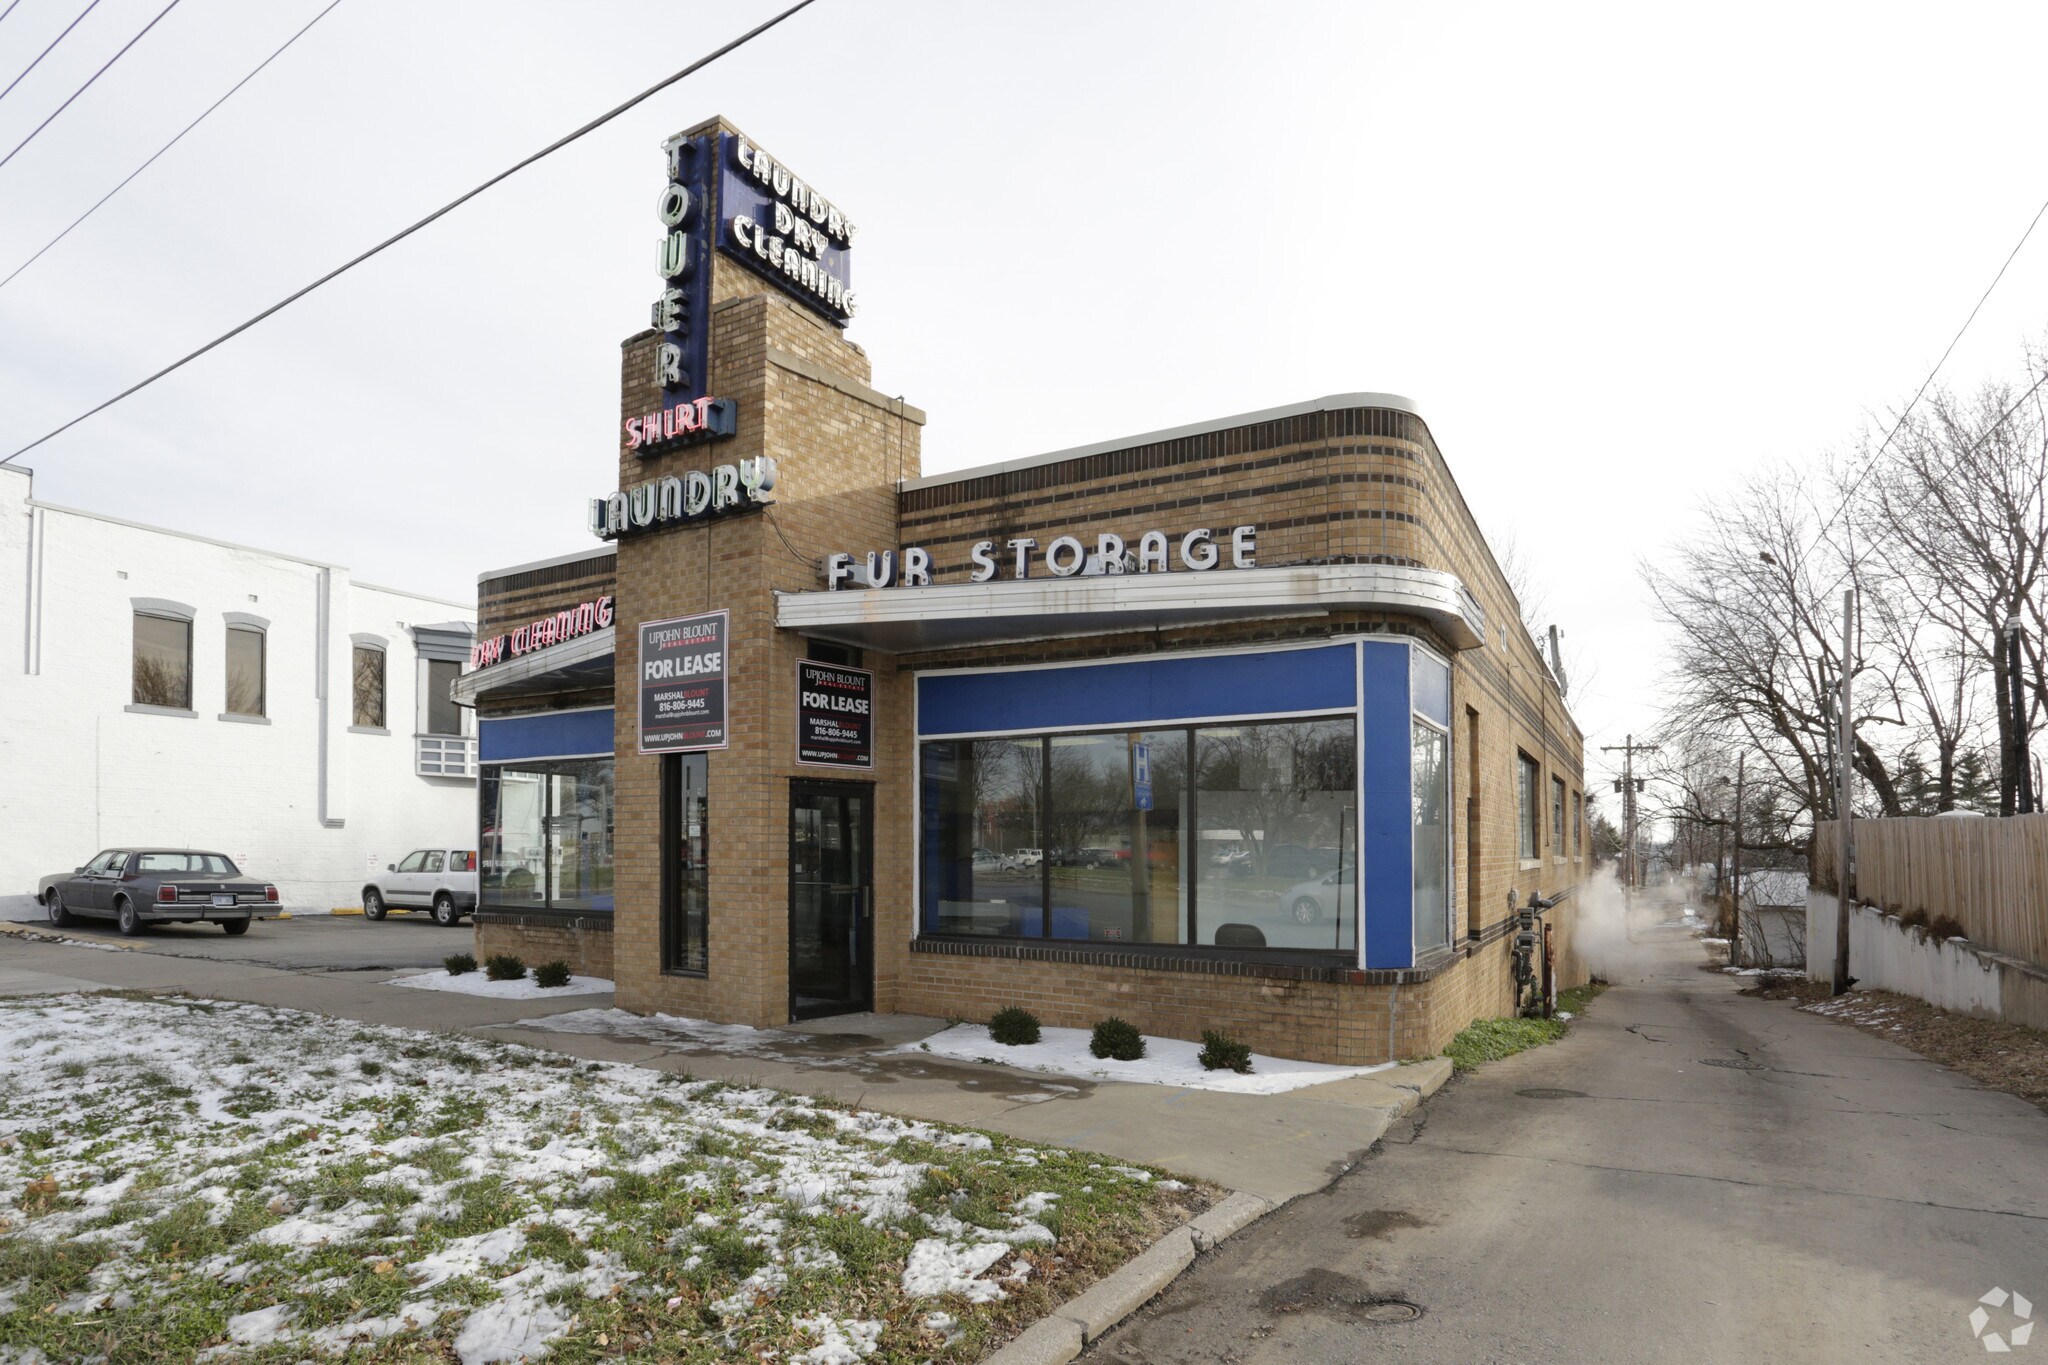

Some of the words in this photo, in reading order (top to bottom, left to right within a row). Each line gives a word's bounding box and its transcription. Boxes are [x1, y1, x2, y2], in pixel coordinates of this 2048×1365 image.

[737, 133, 859, 249] LAUNDRY
[775, 200, 829, 260] DRY
[655, 133, 691, 391] TOWER
[733, 214, 859, 319] CLEANING
[625, 396, 714, 449] SHIRT
[588, 455, 777, 538] LAUNDRY
[828, 547, 933, 592] FUR
[970, 525, 1258, 583] STORAGE
[511, 596, 613, 656] CLEANING
[649, 627, 681, 651] UPJOHN
[683, 622, 718, 639] BLOUNT
[662, 640, 682, 649] REAL
[685, 636, 717, 646] ESTATE
[645, 658, 674, 680] FOR
[675, 652, 721, 677] LEASE
[806, 669, 835, 686] UPJOHN
[837, 675, 865, 687] BLOUNT
[659, 698, 705, 712] 816-806-9445
[802, 691, 829, 709] FOR
[831, 695, 869, 715] LEASE
[815, 726, 858, 739] 816-806-9445
